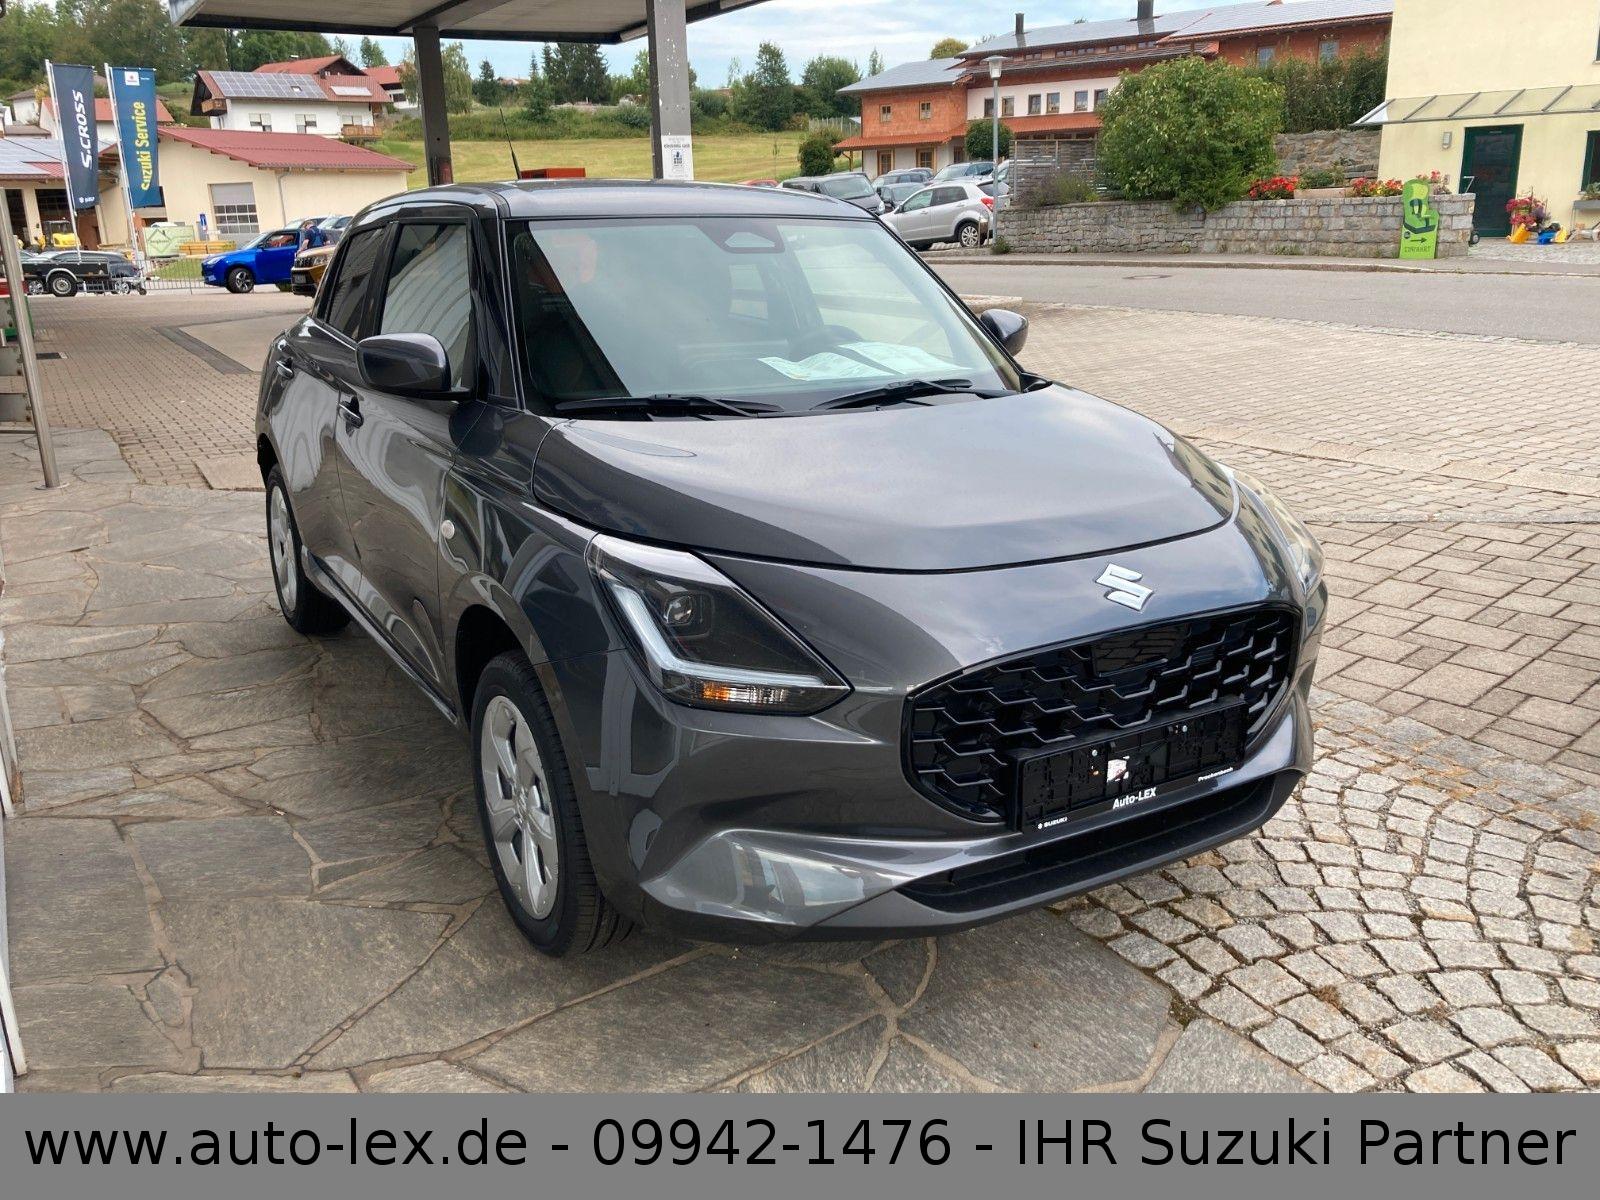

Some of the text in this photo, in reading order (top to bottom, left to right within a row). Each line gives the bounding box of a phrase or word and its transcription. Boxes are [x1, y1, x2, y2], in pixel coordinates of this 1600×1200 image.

[131, 101, 150, 149] Service
[1112, 786, 1157, 810] Auto-LEX
[1043, 816, 1069, 828] SUZUKI
